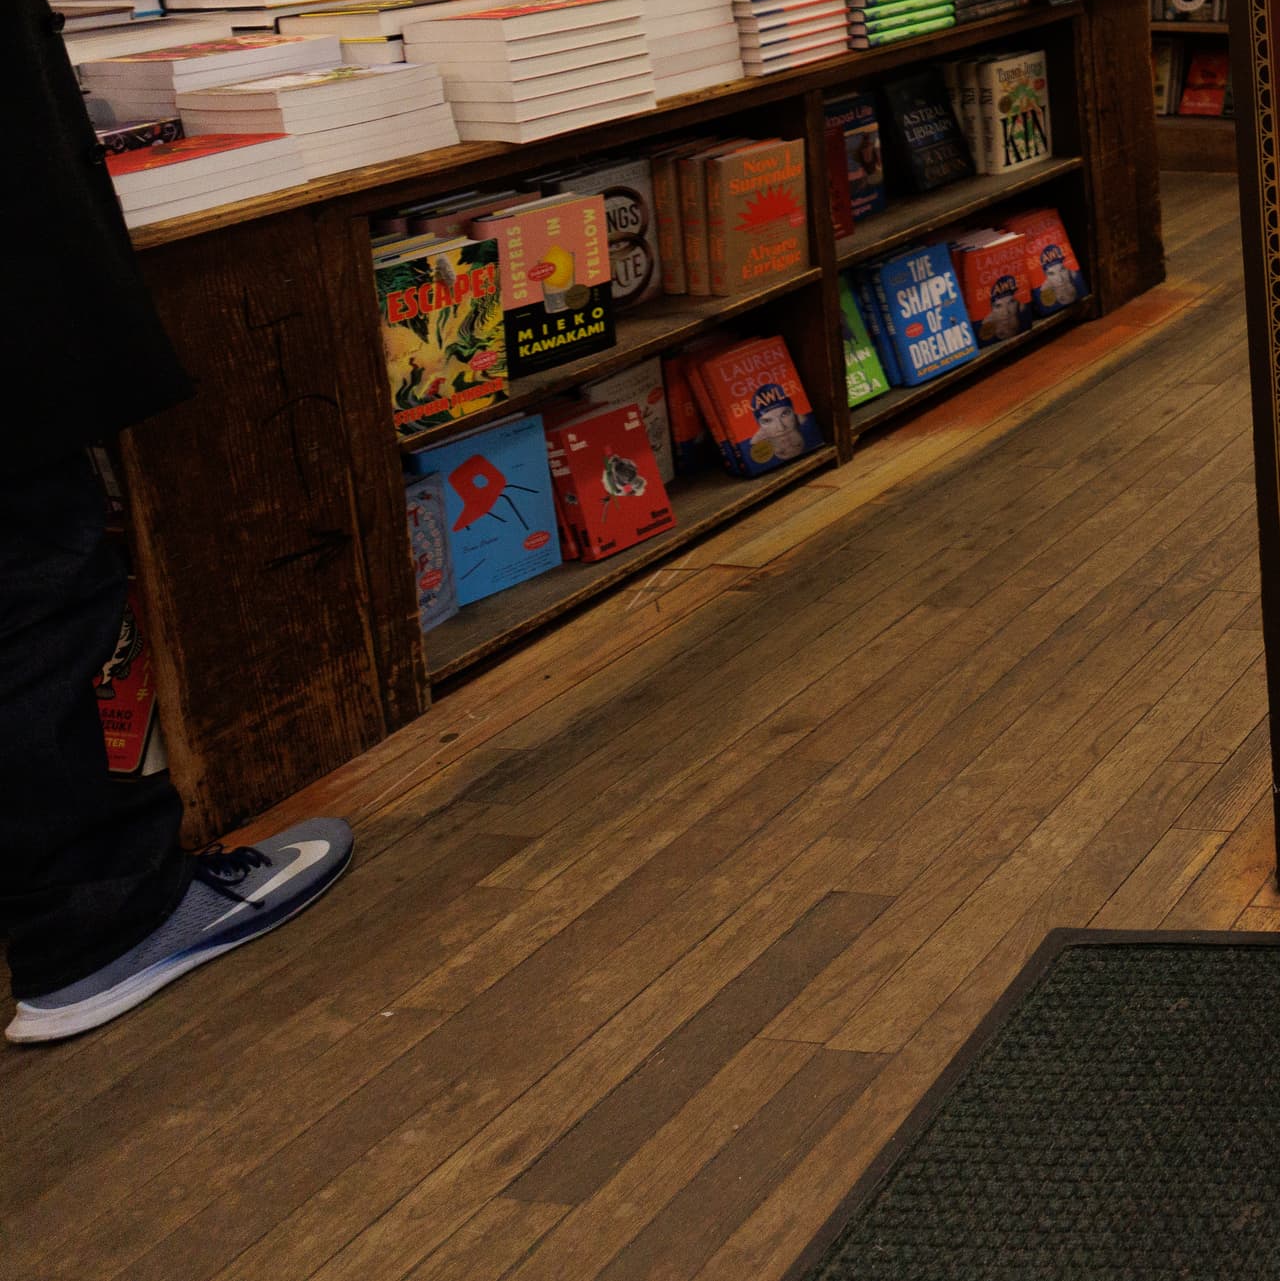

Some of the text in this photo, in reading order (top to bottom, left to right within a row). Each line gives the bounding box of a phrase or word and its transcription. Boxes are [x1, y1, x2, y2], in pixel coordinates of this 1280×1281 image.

[1002, 105, 1049, 167] KIN
[743, 154, 778, 173] Now
[547, 216, 561, 237] IN
[585, 207, 598, 281] YELLOW
[506, 225, 528, 300] SISTERS
[907, 254, 933, 280] THE
[386, 263, 498, 324] ESCAPE!
[896, 272, 957, 319] SHAPE
[926, 307, 943, 333] OF
[518, 321, 605, 358] KAWAKAMI
[908, 321, 973, 369] DREAMS
[719, 348, 785, 383] LAUREN
[730, 366, 790, 398] GROFF
